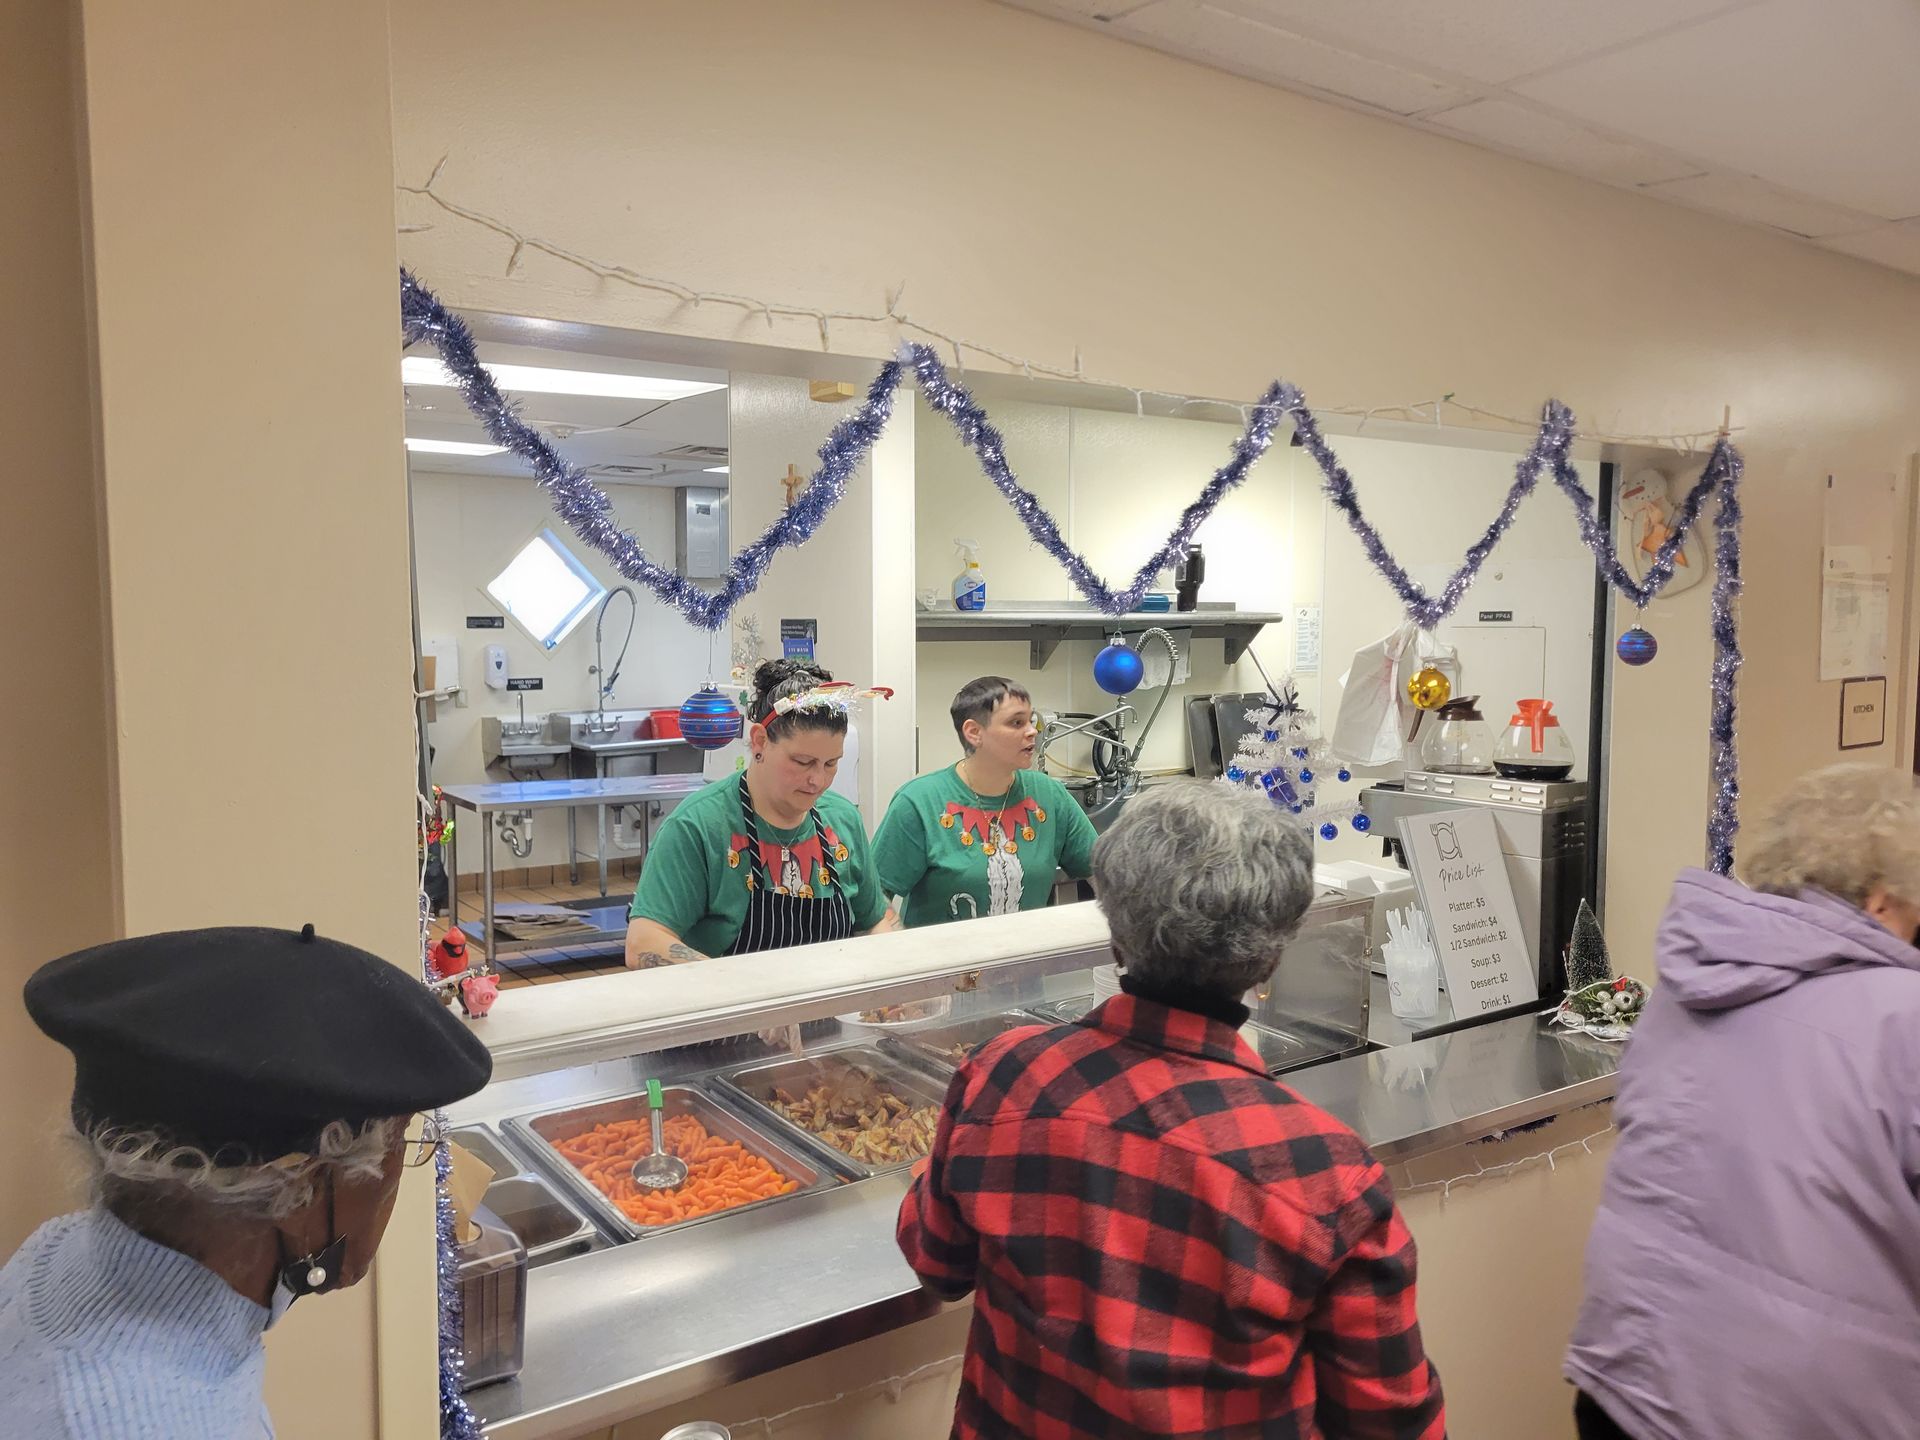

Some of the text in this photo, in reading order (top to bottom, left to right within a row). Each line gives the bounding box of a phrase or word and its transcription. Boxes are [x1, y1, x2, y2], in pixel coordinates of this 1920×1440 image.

[1438, 868, 1465, 892] Price
[1448, 897, 1486, 912] Platter: $5
[1452, 916, 1498, 934] Sandwich: $4
[1450, 930, 1508, 951] 1/2 Sandwich: $2
[1470, 953, 1501, 969] Soup: $3
[1470, 972, 1509, 990] Dessert: $2
[1481, 994, 1512, 1010] Drink: $1
